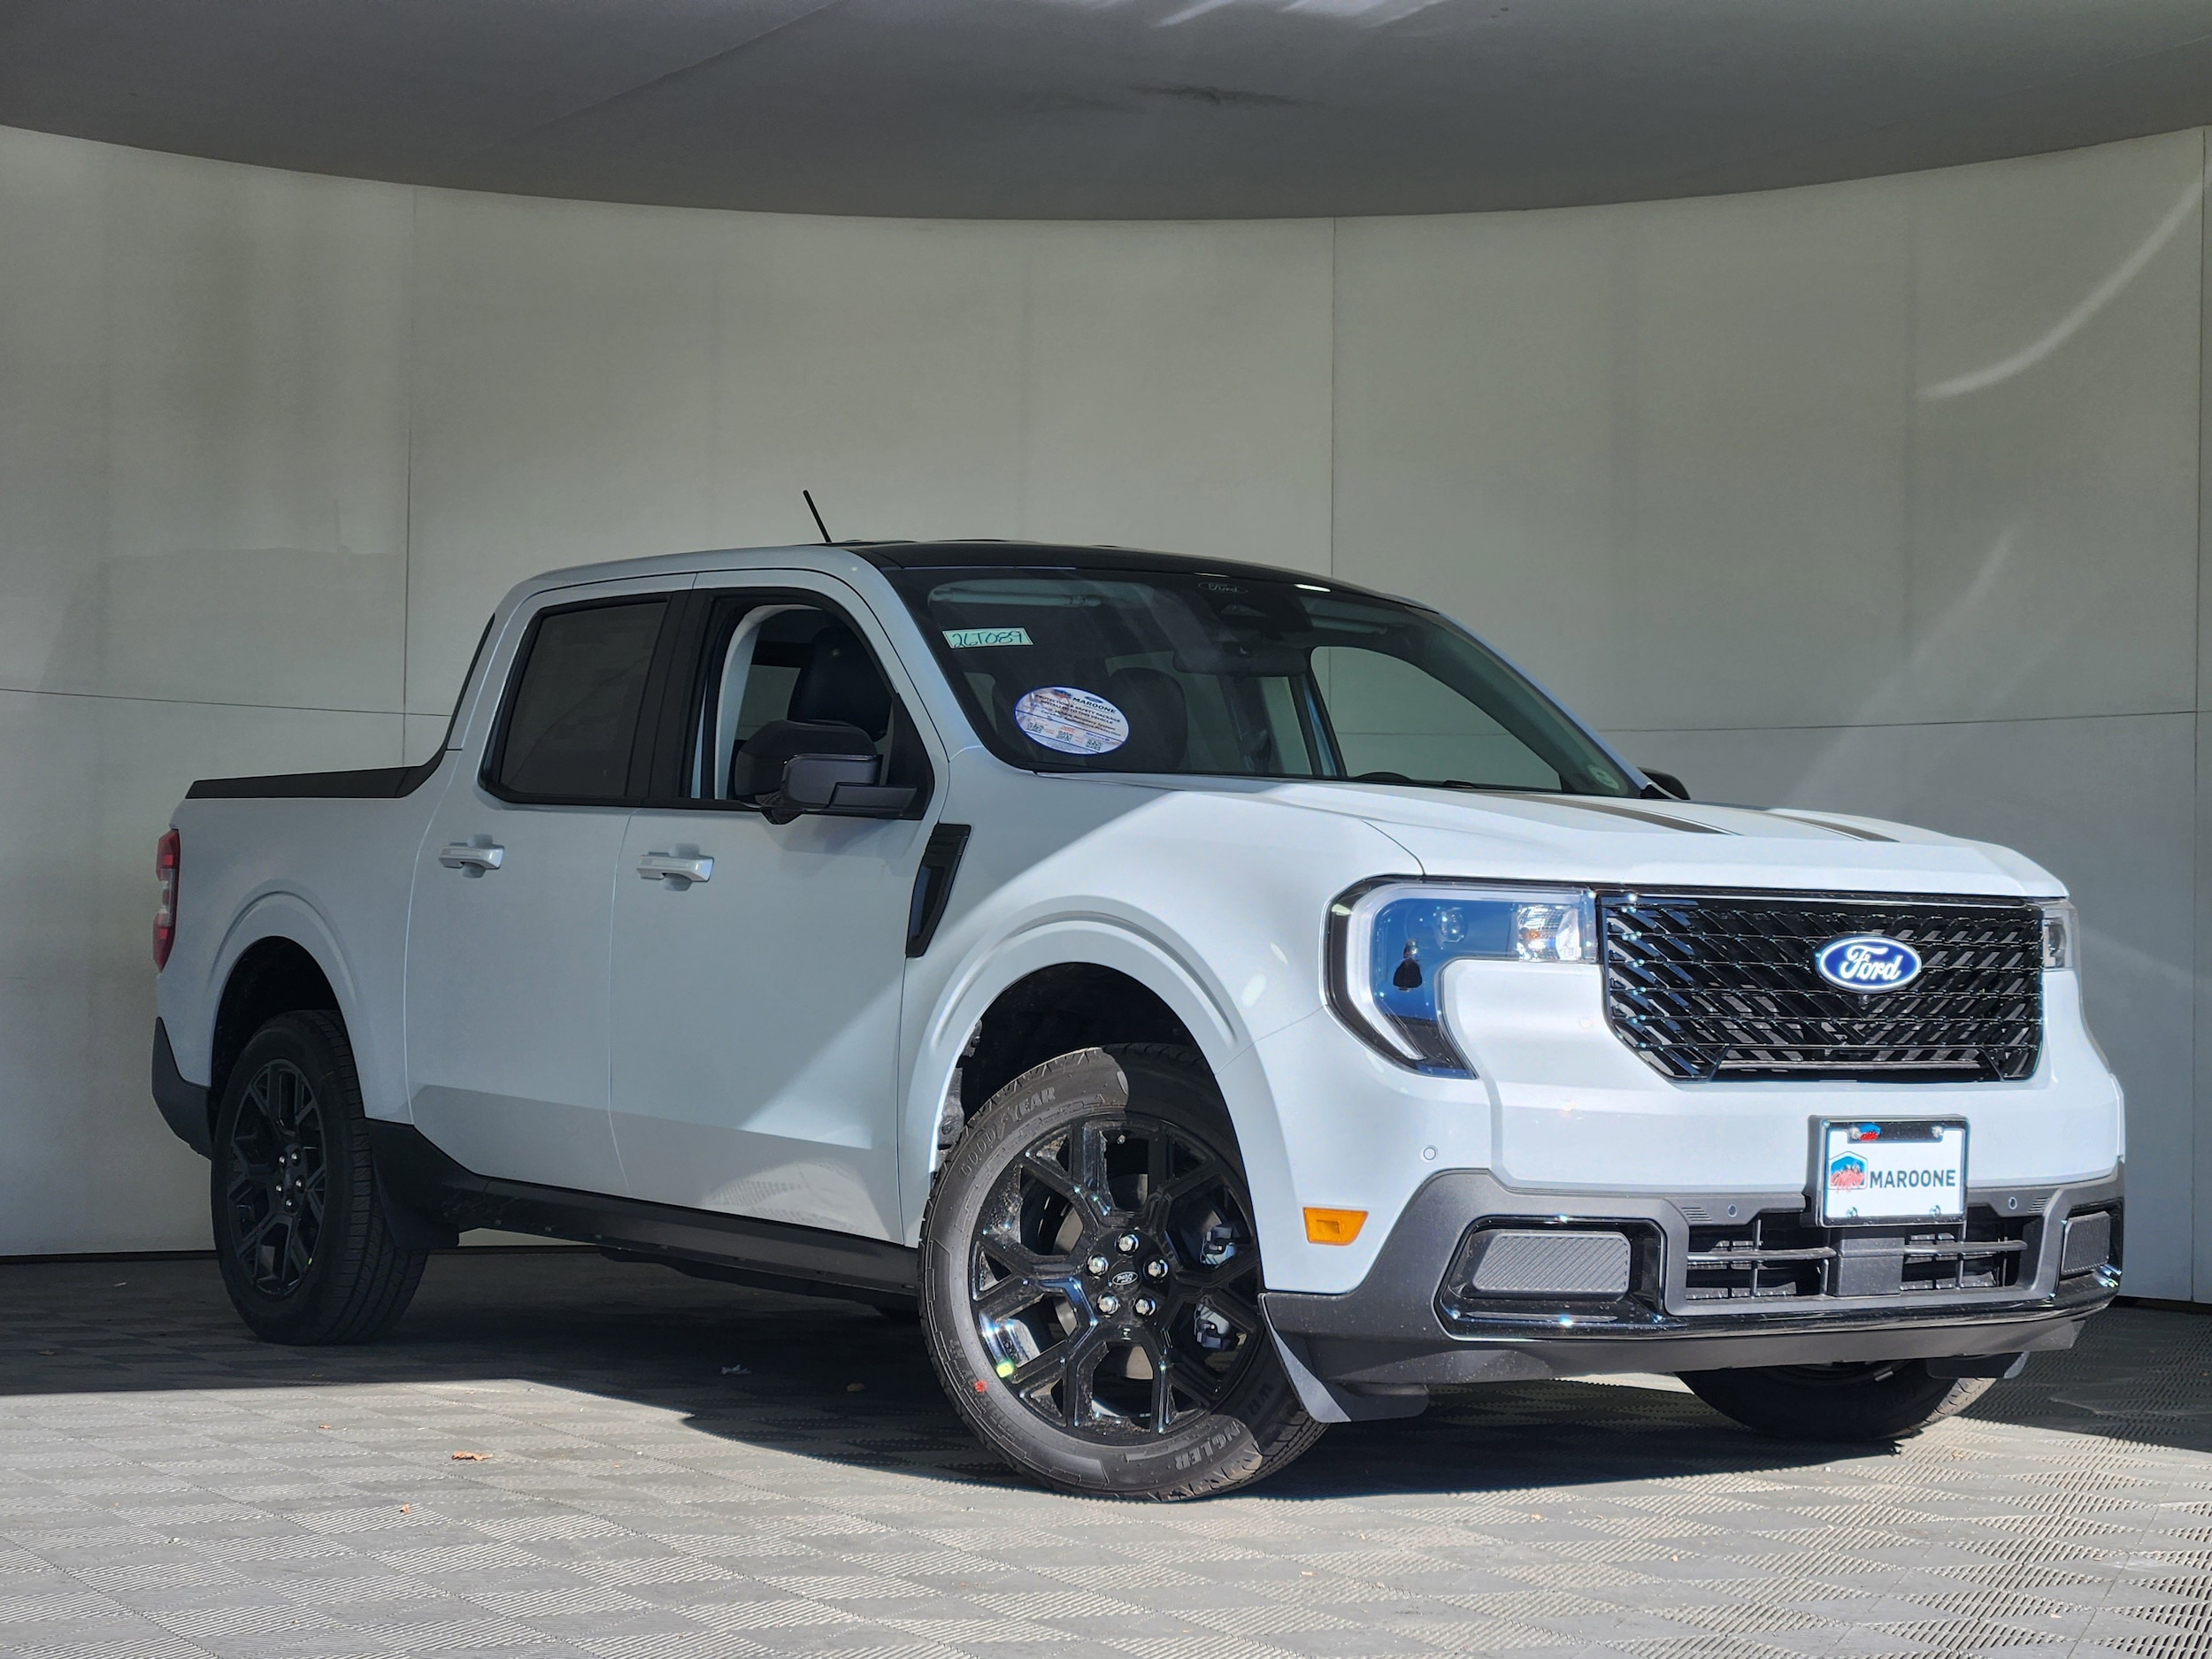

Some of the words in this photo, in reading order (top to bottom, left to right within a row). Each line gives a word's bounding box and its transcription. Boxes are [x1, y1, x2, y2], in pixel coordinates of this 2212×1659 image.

[951, 631, 1023, 649] 26T089
[1035, 694, 1069, 706] PROTECTION
[1075, 705, 1095, 715] SAFETY
[1096, 712, 1120, 723] PACKAGE
[1041, 700, 1069, 711] INSTALLED
[1090, 714, 1113, 725] VEHICLE
[1072, 697, 1117, 713] MAROONE
[1840, 944, 1903, 981] Ford
[1870, 1170, 1955, 1188] MAROONE
[1116, 1273, 1133, 1283] Ford
